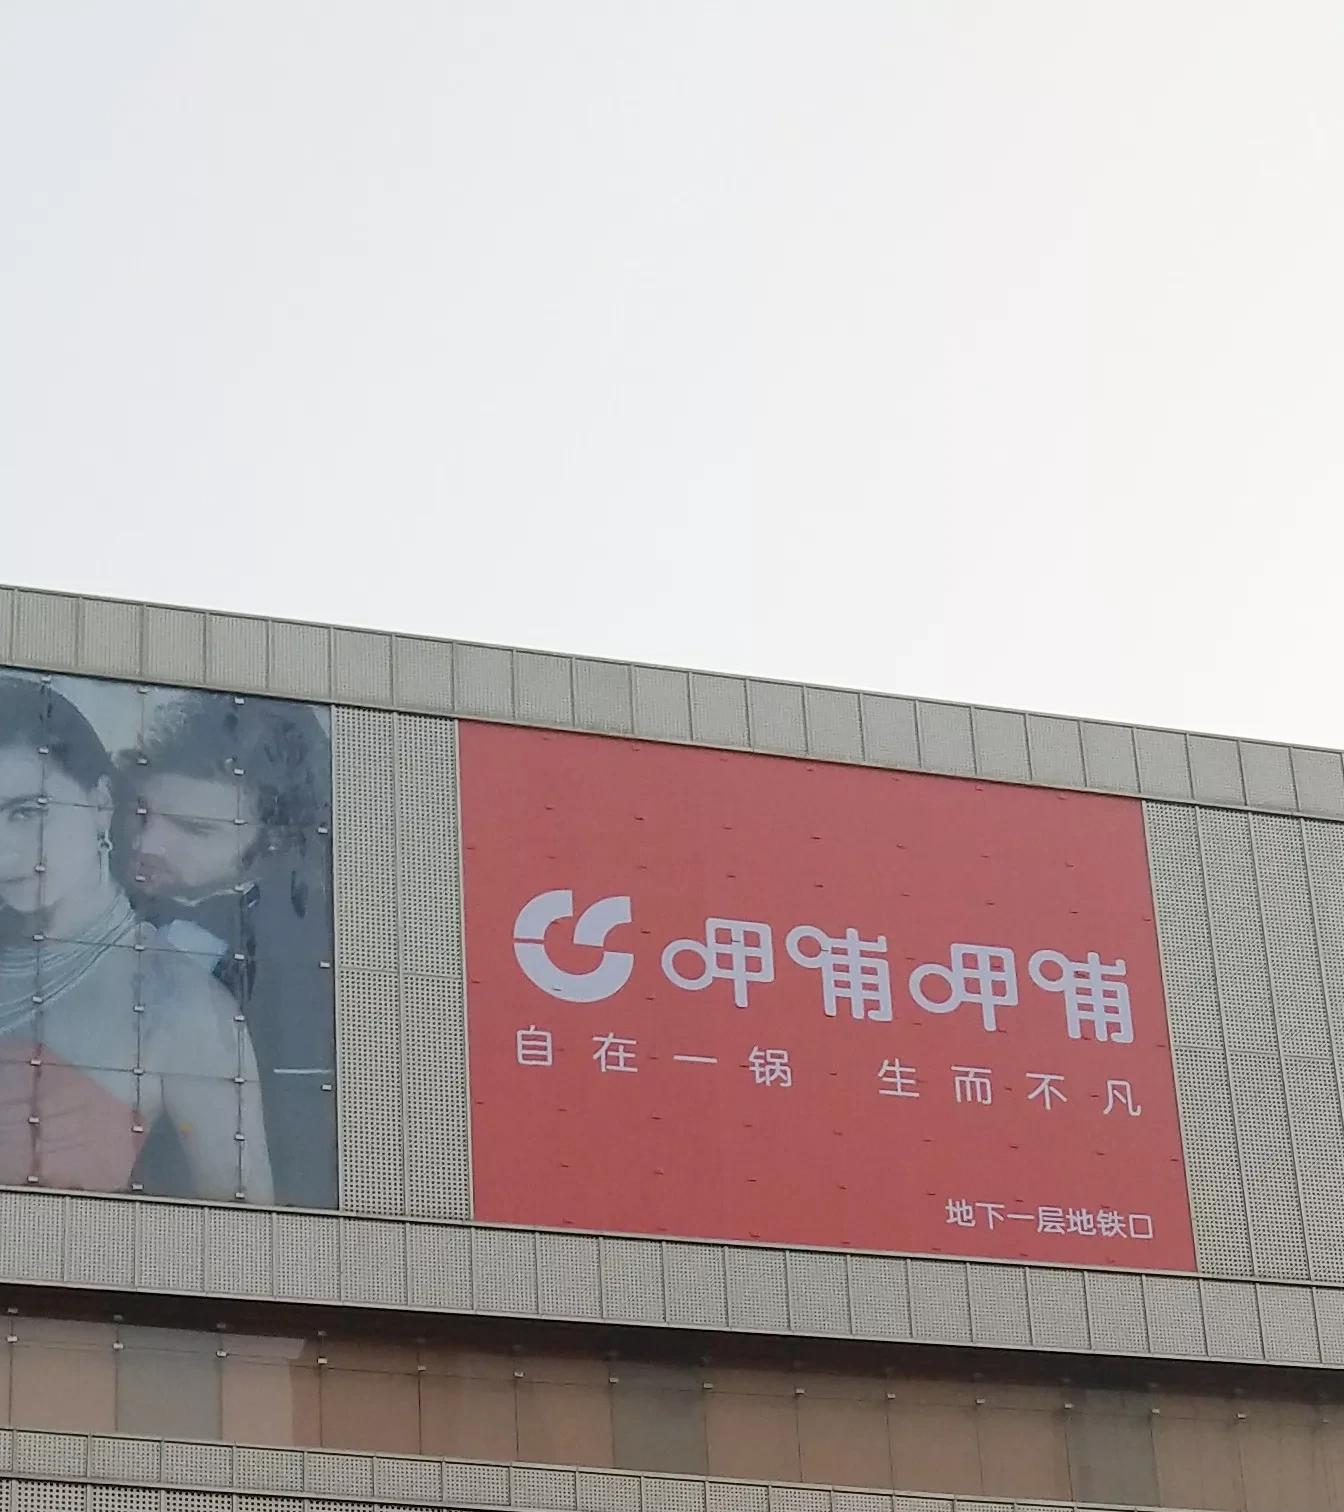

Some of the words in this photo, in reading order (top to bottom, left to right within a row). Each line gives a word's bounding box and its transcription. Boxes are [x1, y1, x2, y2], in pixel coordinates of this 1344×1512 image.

[661, 916, 1135, 1044] 呷哺呷哺
[515, 1025, 793, 1089] 自在一锅
[876, 1059, 1143, 1117] 生而不凡
[944, 1197, 1154, 1242] 地下一层地铁口
